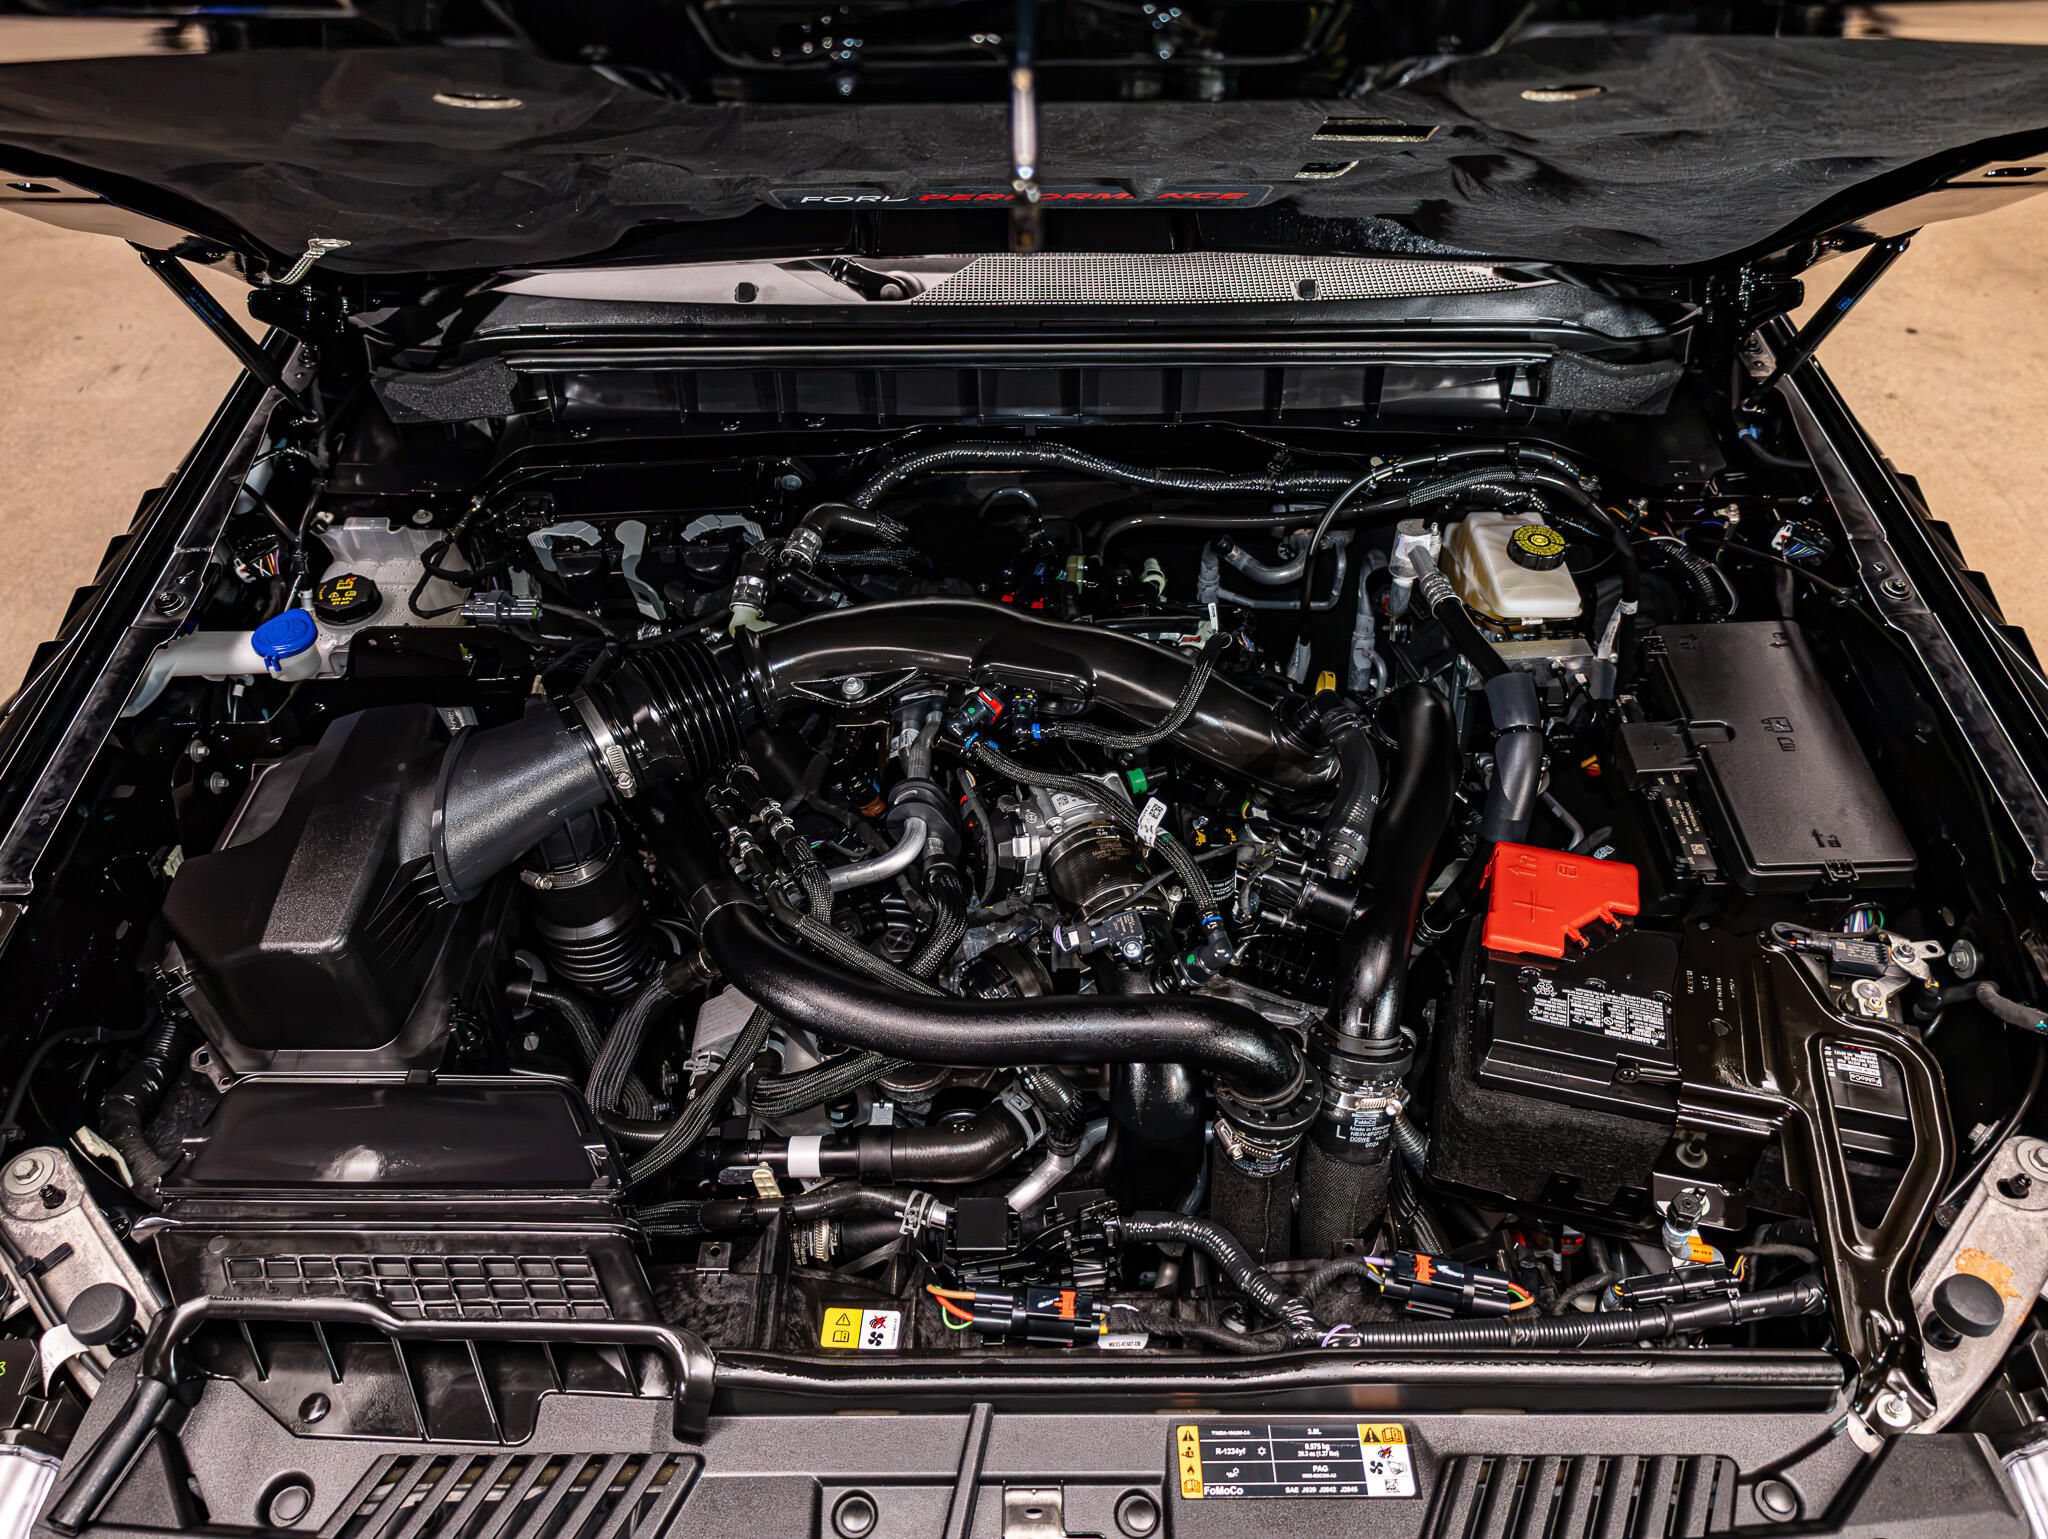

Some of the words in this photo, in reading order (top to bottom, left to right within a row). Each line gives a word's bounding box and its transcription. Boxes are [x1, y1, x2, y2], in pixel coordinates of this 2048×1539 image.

[918, 192, 1249, 201] PERORMNCE
[1850, 1073, 1880, 1084] FoMoCo
[1336, 1125, 1346, 1140] L
[1312, 1465, 1329, 1473] PAG
[1204, 1485, 1244, 1496] FoMoCo
